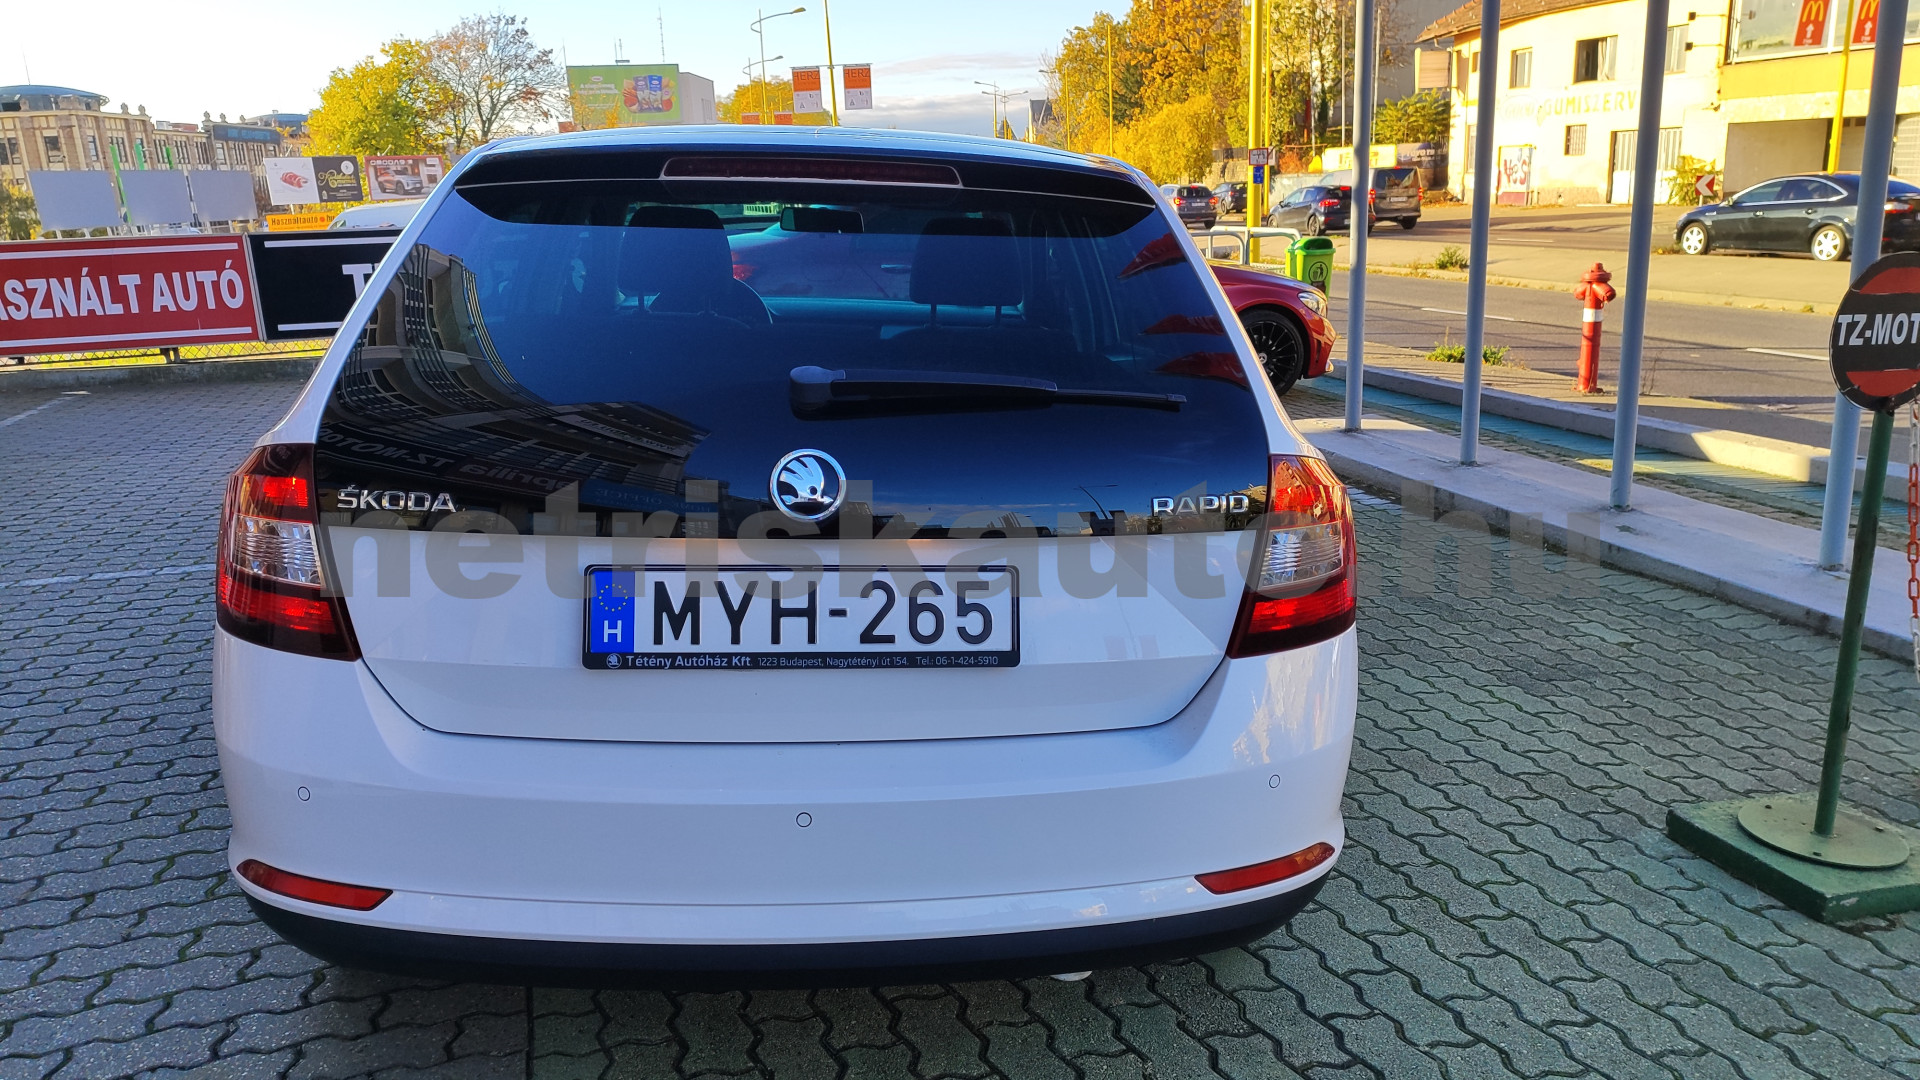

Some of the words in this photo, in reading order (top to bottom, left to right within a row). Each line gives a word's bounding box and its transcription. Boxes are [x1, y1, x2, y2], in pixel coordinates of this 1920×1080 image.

[152, 260, 244, 313] AUTÓ
[342, 263, 381, 303] T
[337, 485, 457, 513] ŠKODA
[1152, 494, 1249, 517] RAPID
[652, 580, 994, 645] MYH-265
[603, 620, 622, 643] H
[626, 655, 670, 669] Tétény
[675, 655, 728, 667] Autóház
[757, 657, 778, 666] 1223
[780, 656, 824, 669] Budapest,
[826, 656, 879, 668] Nagytétényi
[881, 656, 891, 666] út
[892, 657, 909, 666] 154.
[935, 656, 999, 666] 06-1-424-5910
